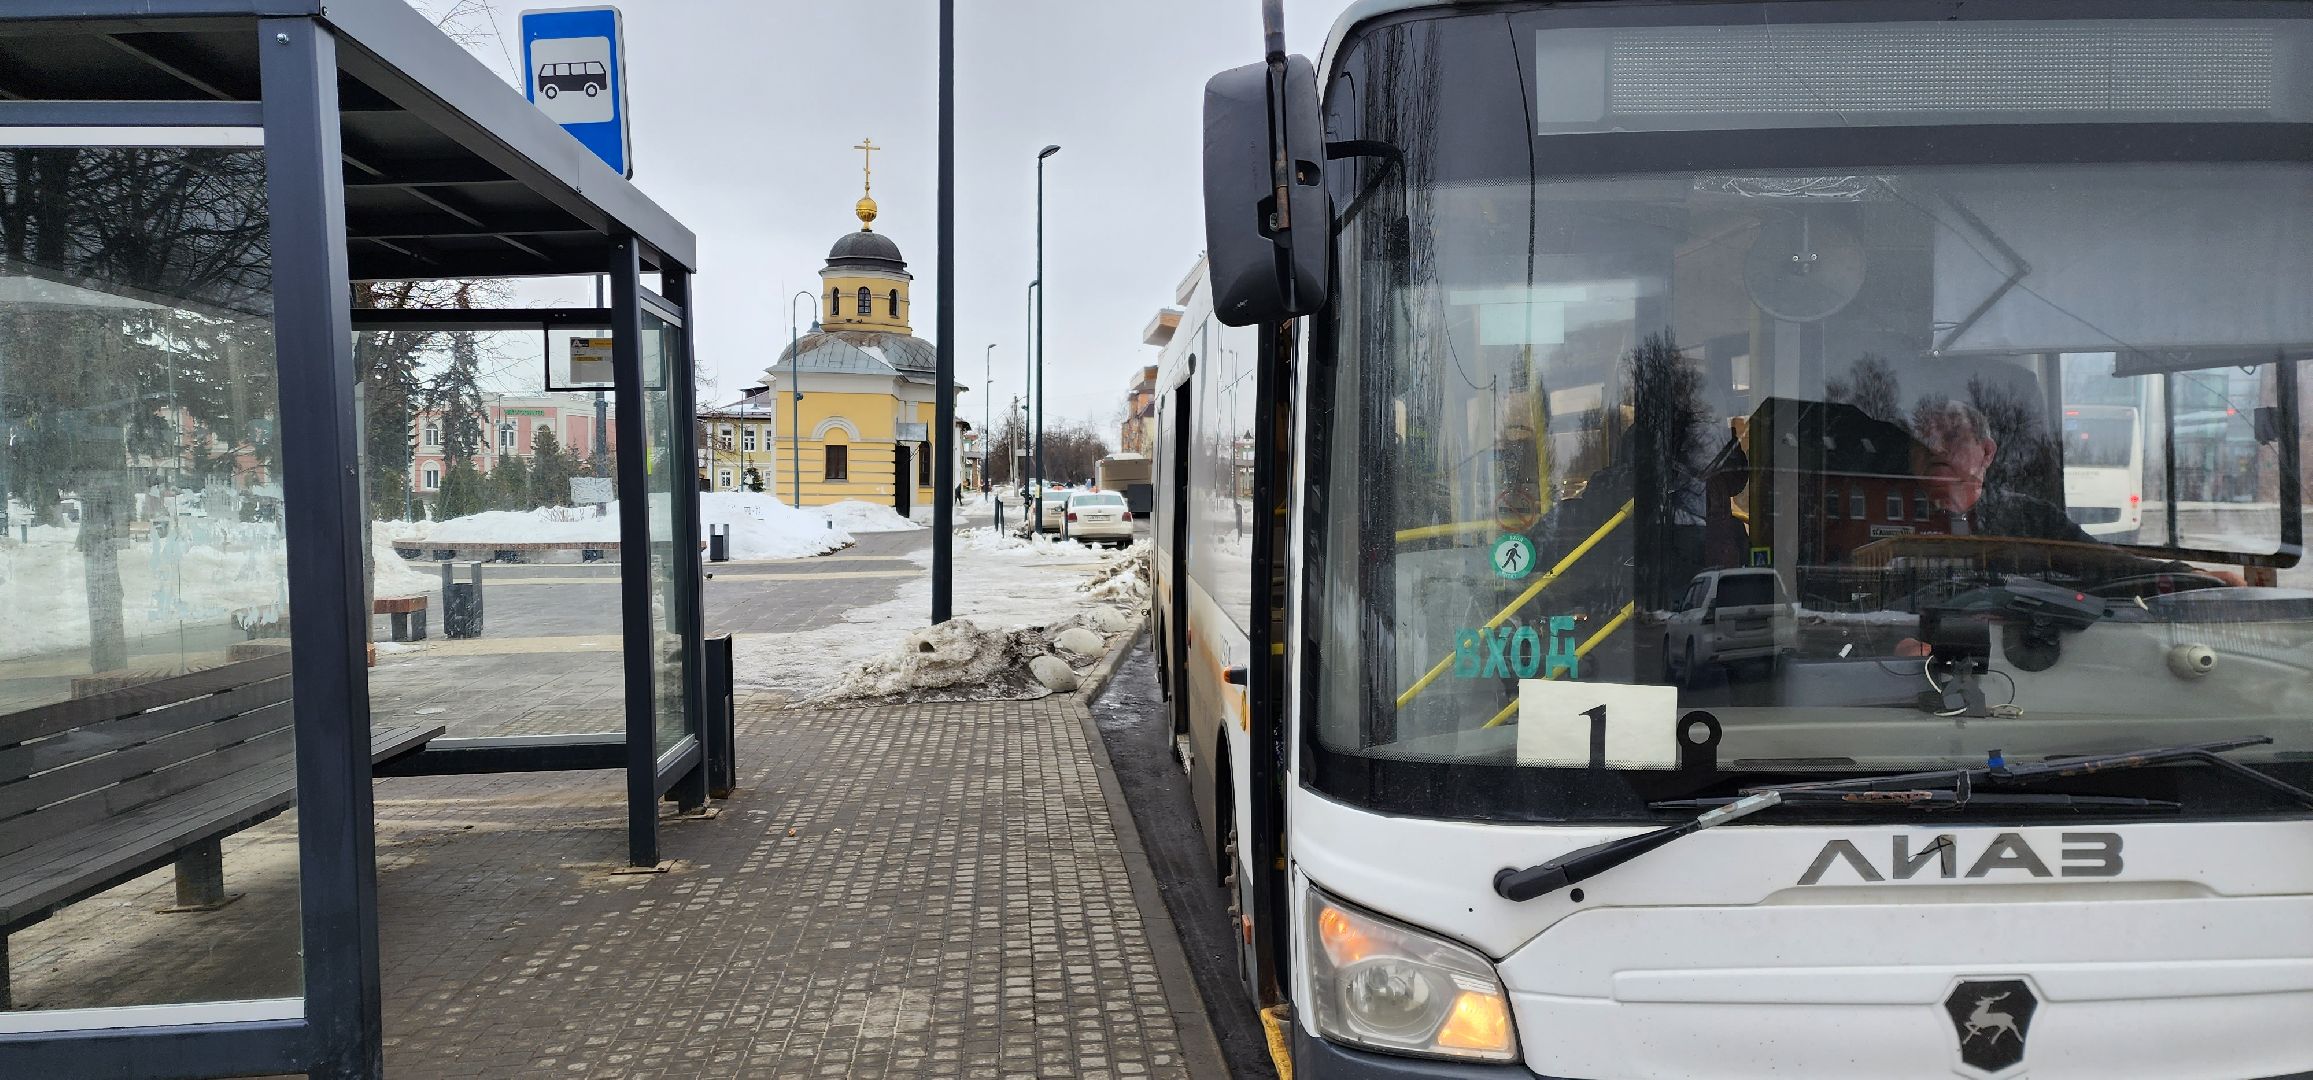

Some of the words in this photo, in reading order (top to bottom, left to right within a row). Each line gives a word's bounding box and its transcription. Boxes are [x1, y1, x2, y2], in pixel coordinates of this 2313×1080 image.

[1455, 615, 1579, 679] ВХОД
[1578, 703, 1607, 769] 1
[1796, 832, 2124, 885] ЛИАЗ
